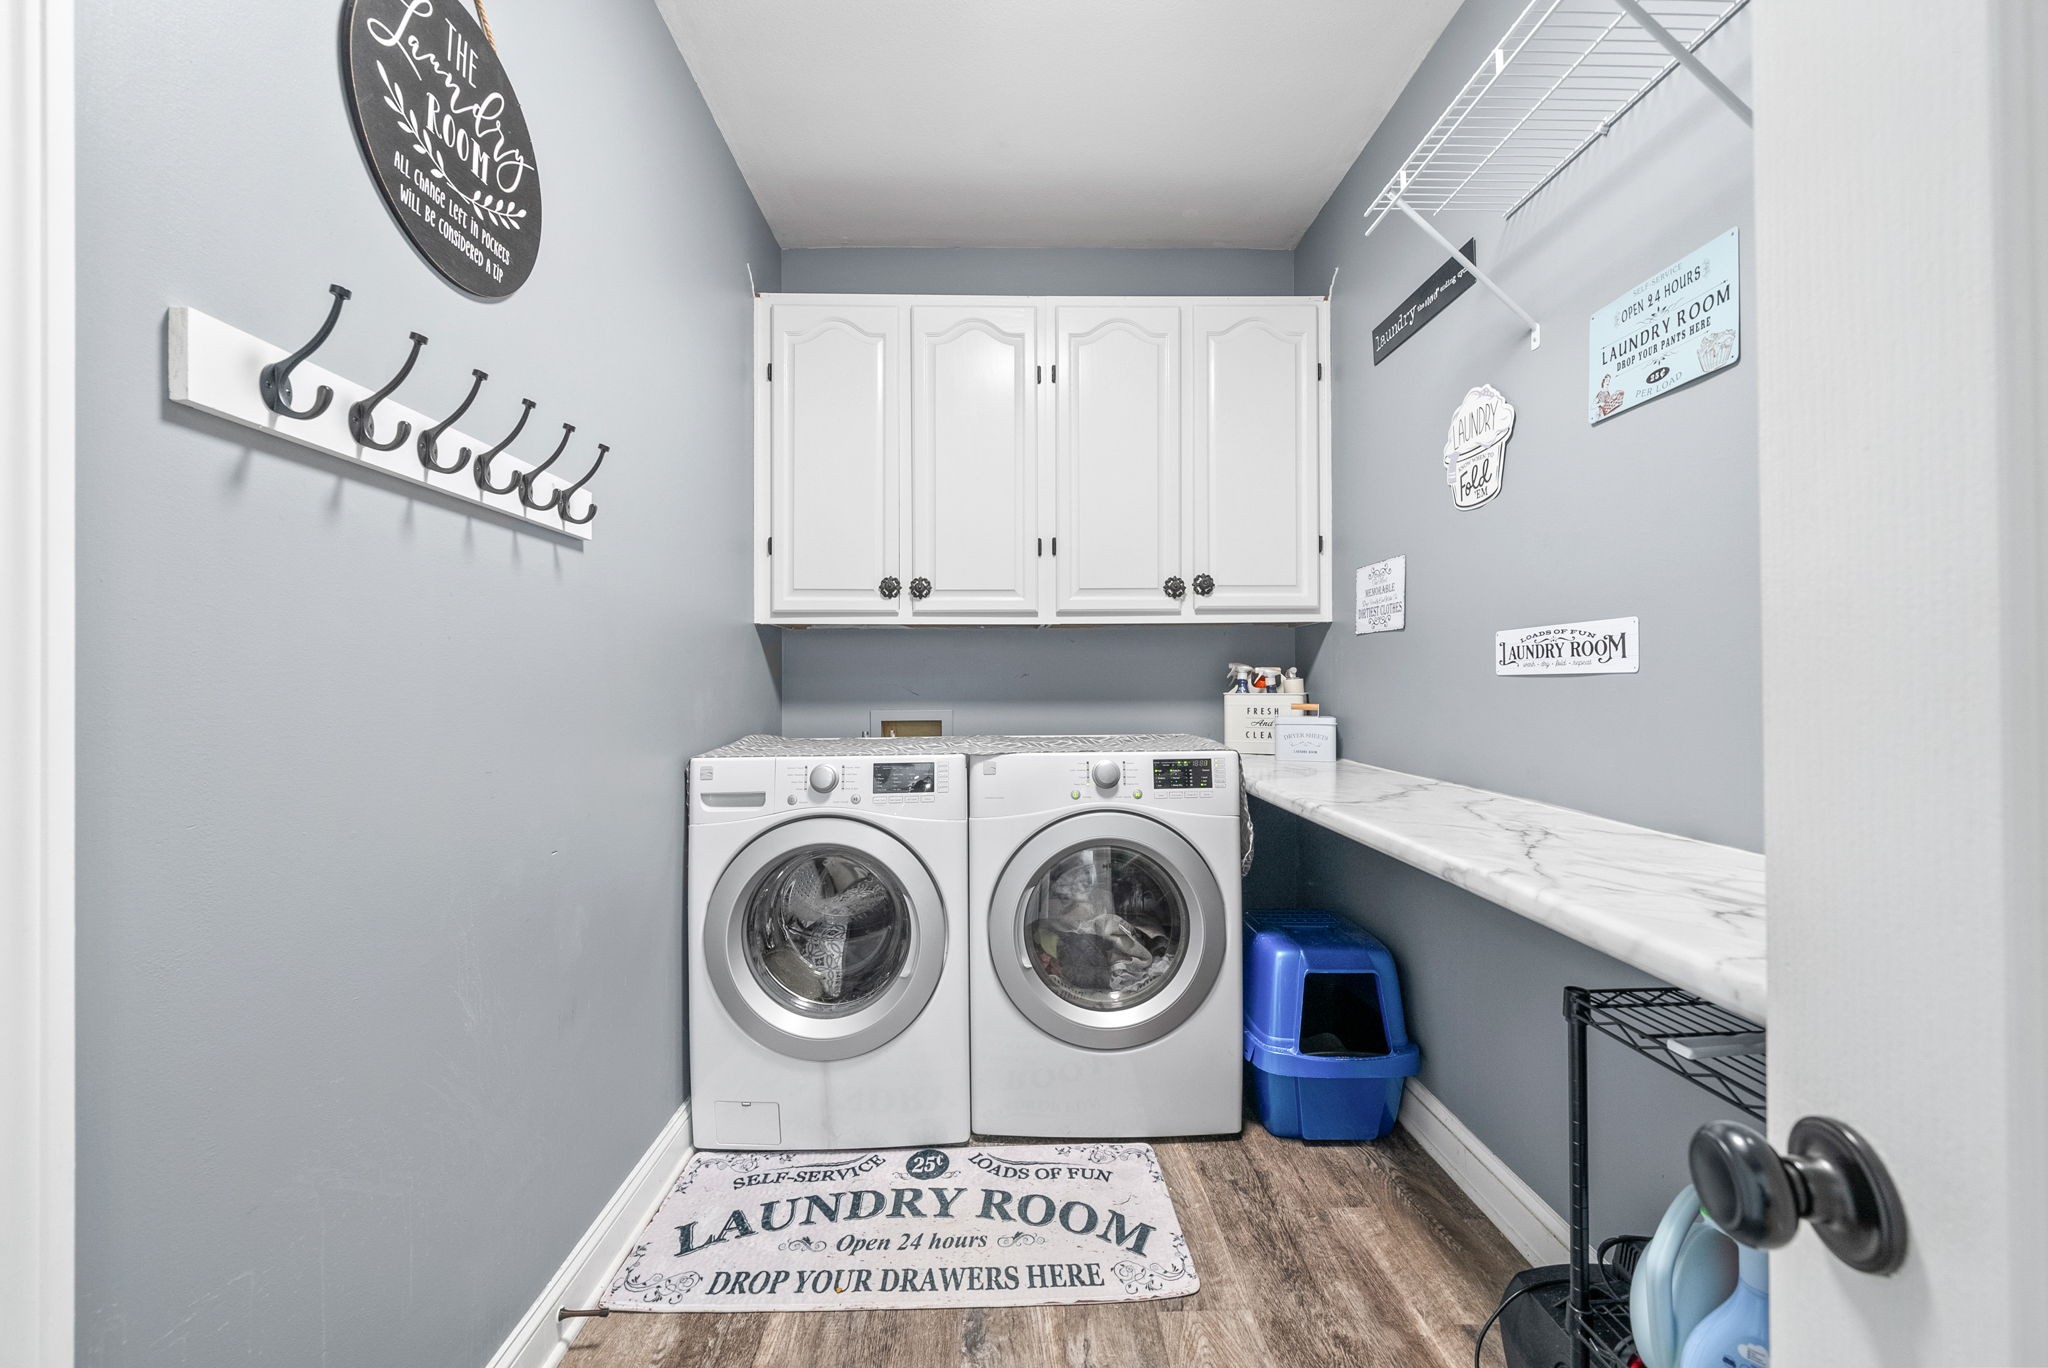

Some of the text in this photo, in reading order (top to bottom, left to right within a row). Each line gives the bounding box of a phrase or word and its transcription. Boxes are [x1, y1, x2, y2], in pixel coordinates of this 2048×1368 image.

[445, 17, 480, 88] THE
[366, 0, 535, 194] Laundry
[426, 92, 491, 186] ROOM
[394, 150, 411, 179] ALL
[485, 258, 491, 275] A
[1621, 265, 1702, 324] OPEN 24 HOURS
[1375, 304, 1417, 352] laundry
[1602, 284, 1731, 366] LAUNDRY ROOM
[1616, 316, 1712, 372] DROP YOUR PANTS HERE
[1635, 371, 1683, 399] PER LOAD
[1453, 400, 1499, 451] LAUNDRY
[1460, 458, 1493, 502] Fold
[1499, 632, 1627, 667] LAUNDRY ROOM
[1520, 630, 1551, 643] LOADS
[1570, 629, 1597, 639] FUN
[1247, 707, 1279, 715] FRESH
[1251, 719, 1273, 727] And
[1246, 731, 1273, 739] CLEA
[733, 1153, 887, 1191] SELF-SERVICE
[912, 1154, 944, 1173] 25¢
[968, 1152, 1114, 1184] LOADS OF FUN
[673, 1186, 1157, 1258] LAUNDRY ROOM
[836, 1232, 988, 1256] Open 24 hours
[705, 1262, 1106, 1296] DROP YOUR DRAWERS HERE
